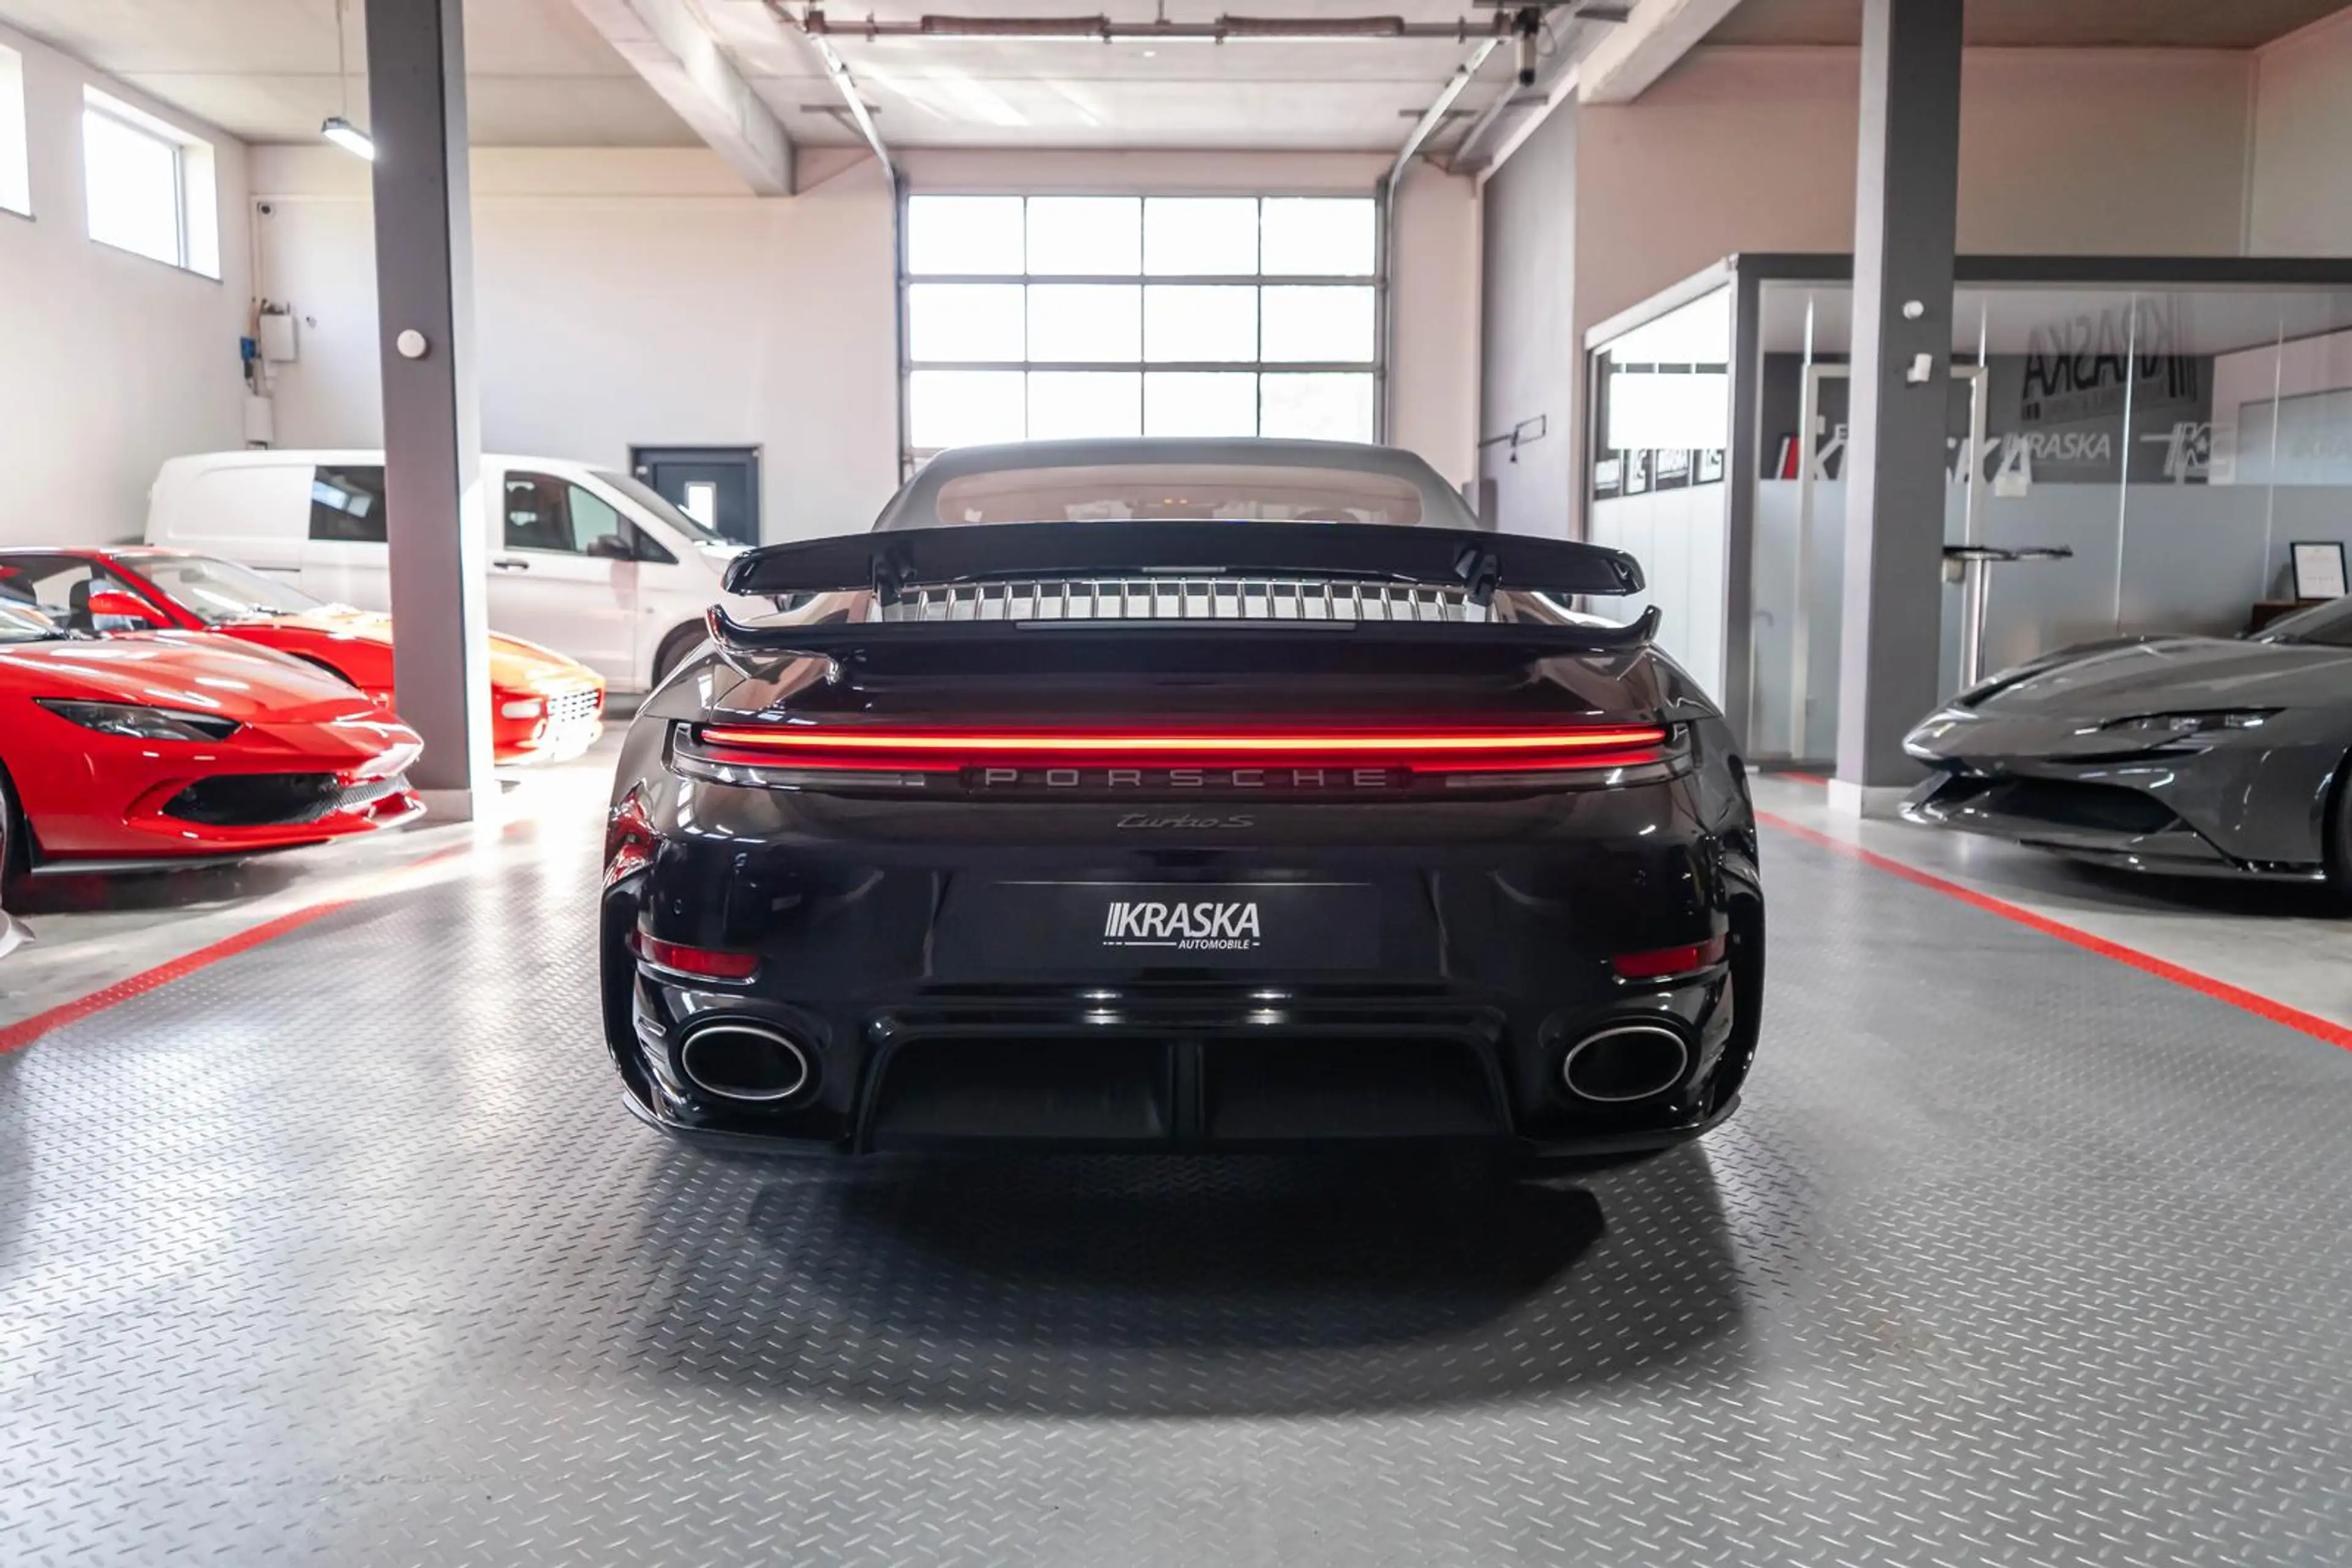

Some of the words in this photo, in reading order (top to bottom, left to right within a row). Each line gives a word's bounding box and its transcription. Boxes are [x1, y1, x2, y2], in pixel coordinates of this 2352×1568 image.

[985, 769, 1387, 787] PORSCHE
[1218, 814, 1256, 828] S
[1105, 902, 1261, 937] KRASKA
[1177, 939, 1251, 949] AUTOMOBILE
